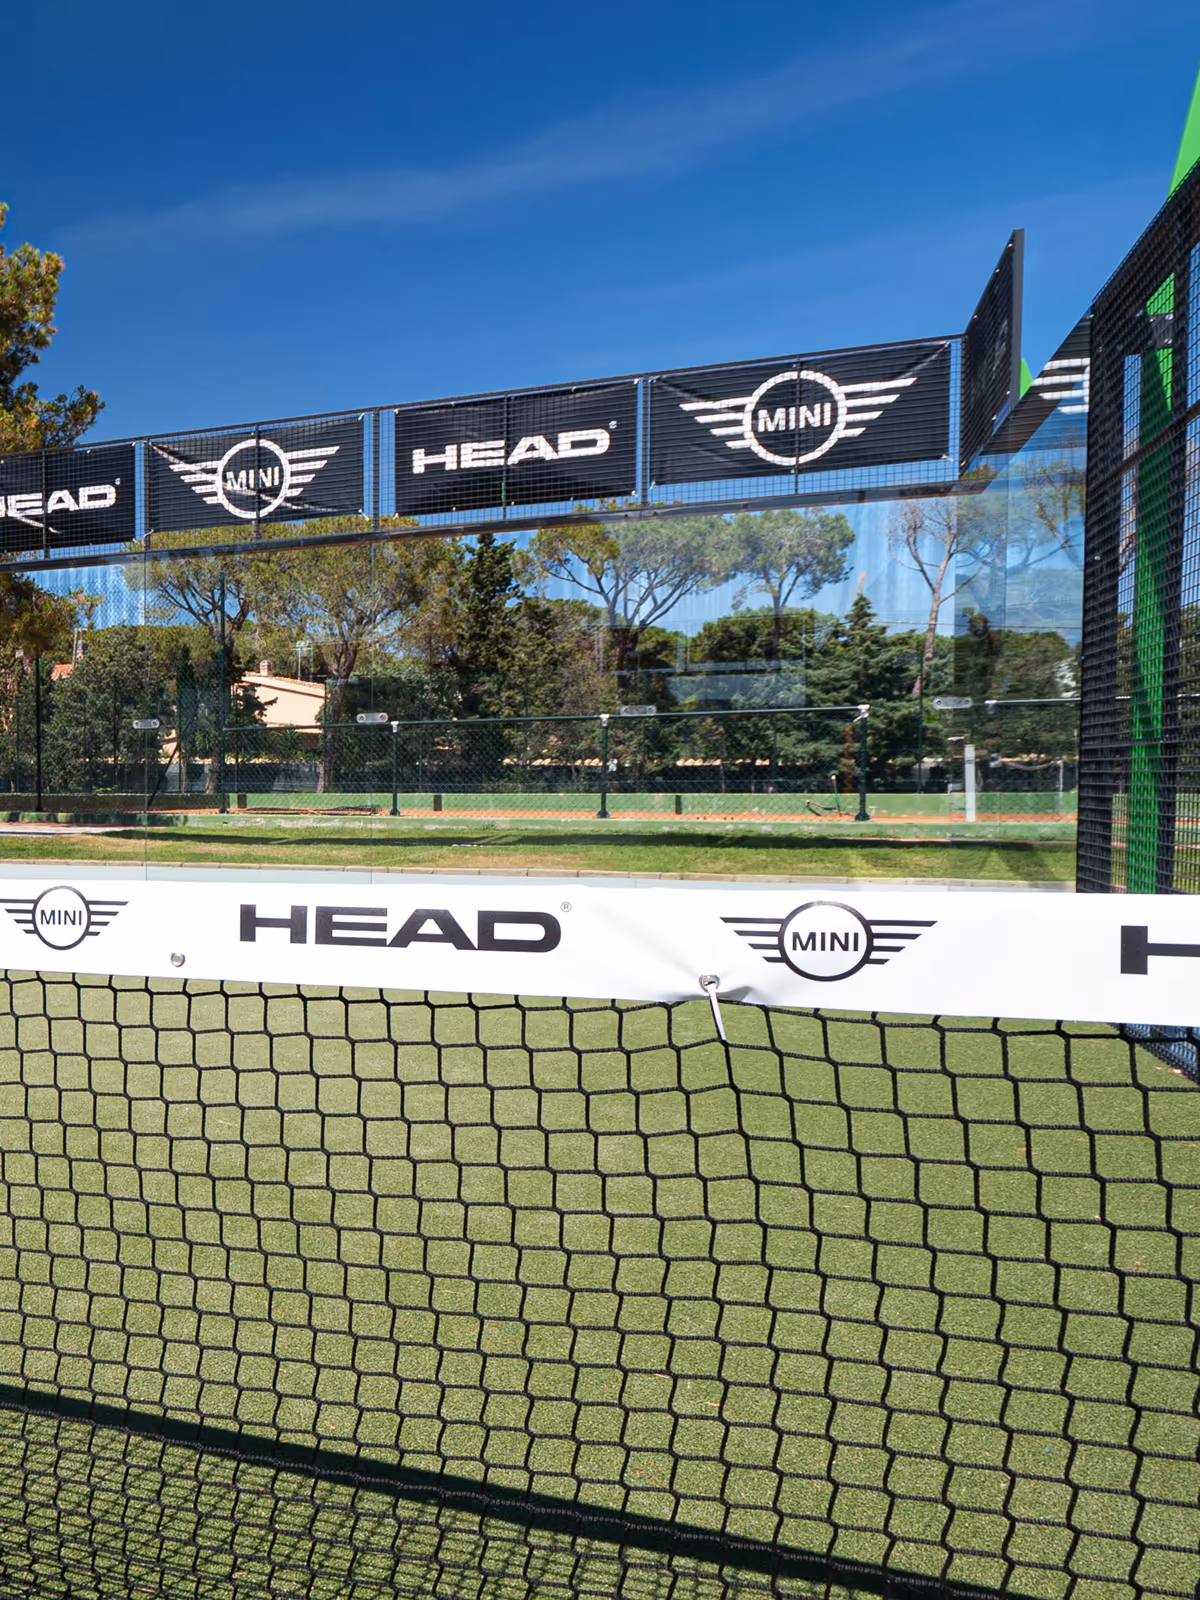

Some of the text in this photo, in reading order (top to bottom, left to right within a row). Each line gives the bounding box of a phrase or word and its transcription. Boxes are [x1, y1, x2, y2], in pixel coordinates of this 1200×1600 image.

[758, 402, 831, 432] MINI
[412, 428, 610, 474] HEAD
[226, 466, 280, 491] MINI
[40, 909, 83, 926] MINI
[792, 931, 860, 952] MINI
